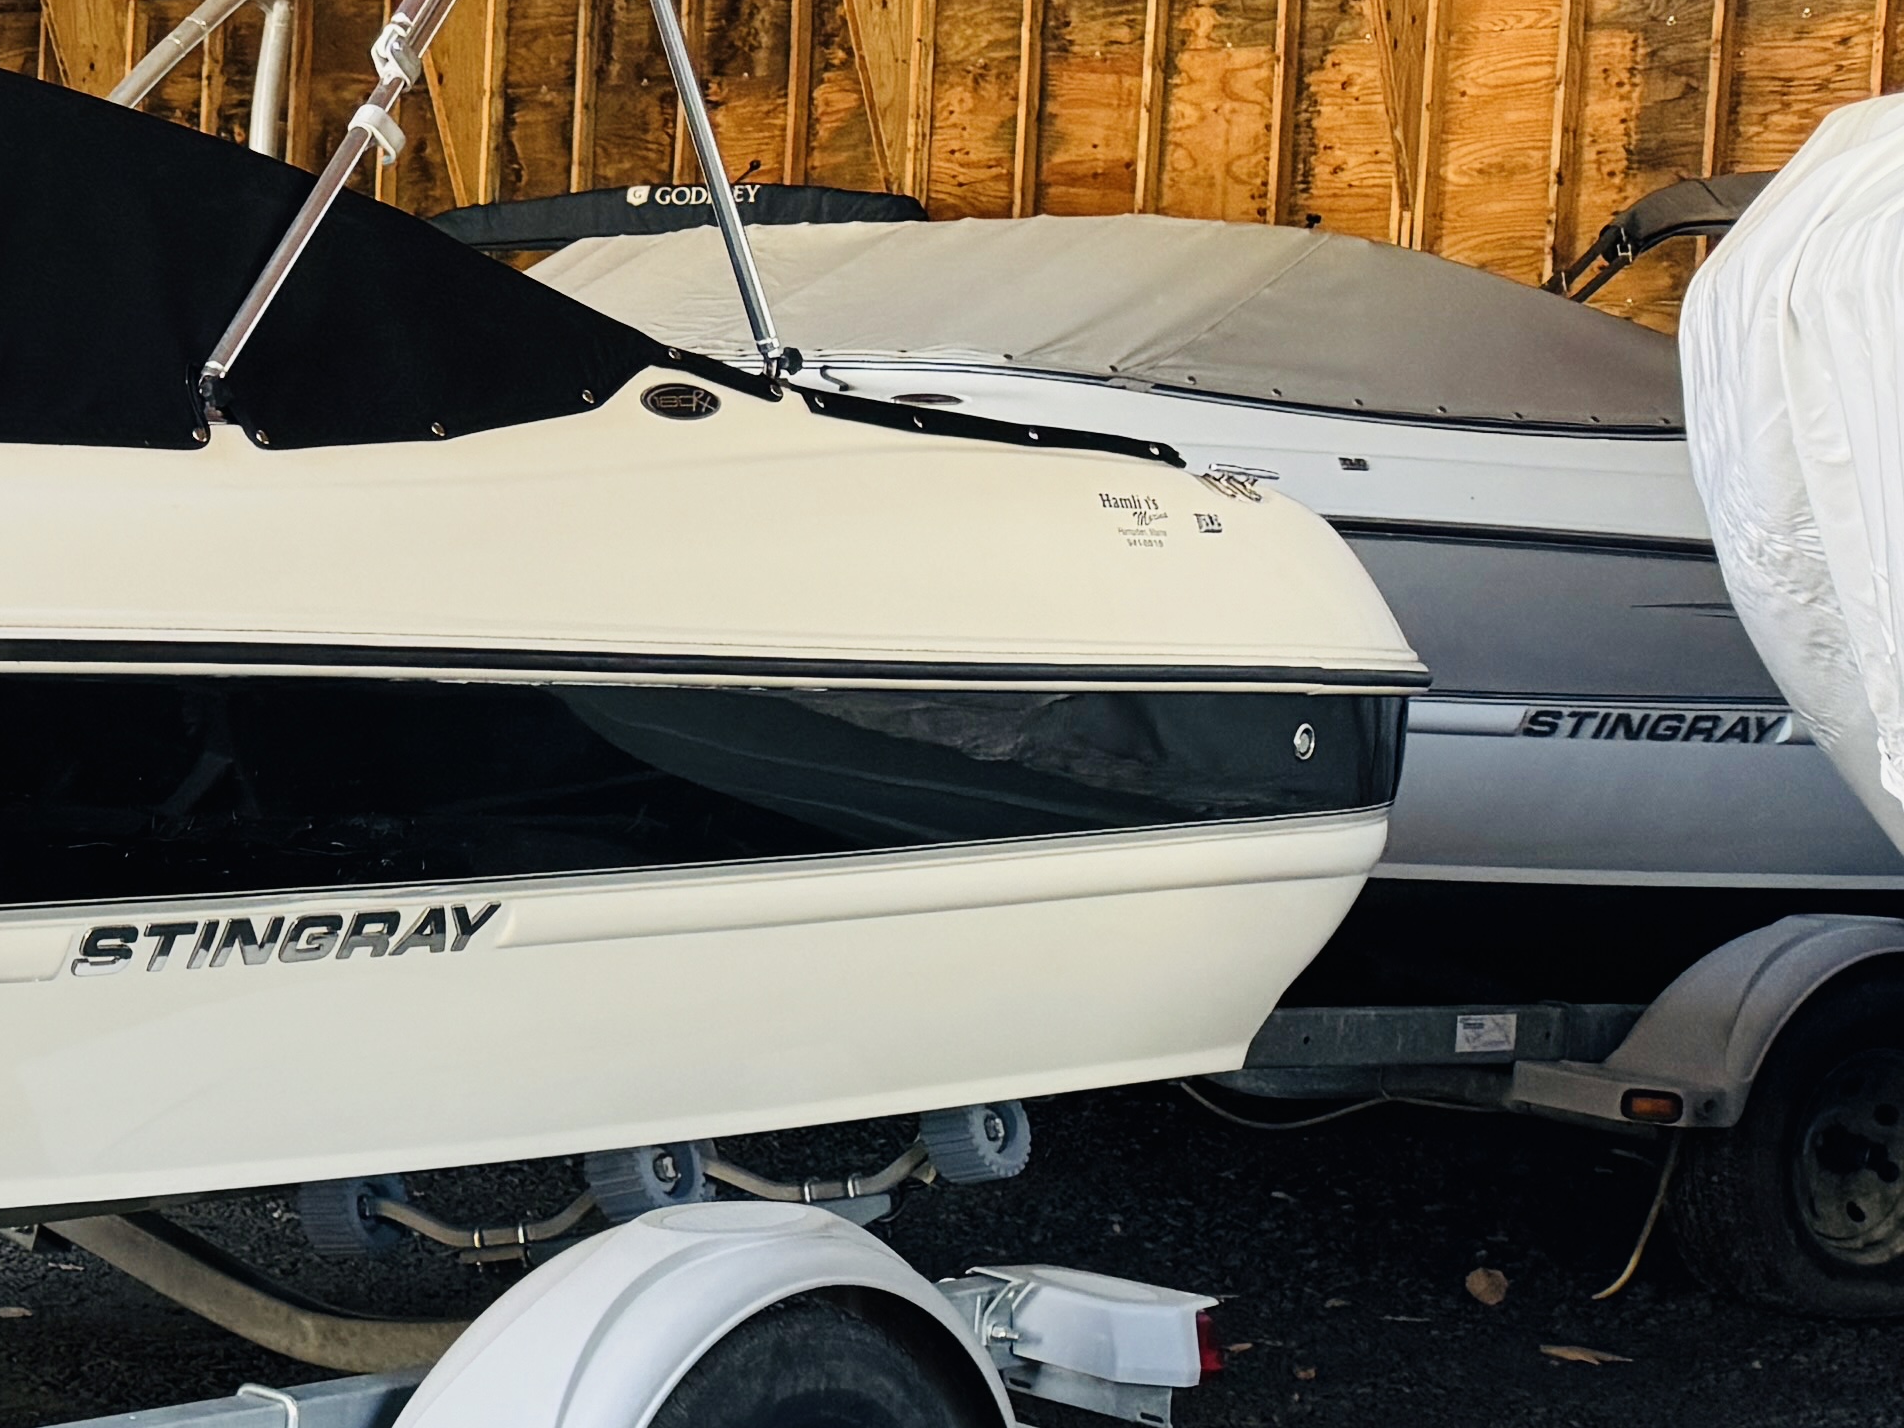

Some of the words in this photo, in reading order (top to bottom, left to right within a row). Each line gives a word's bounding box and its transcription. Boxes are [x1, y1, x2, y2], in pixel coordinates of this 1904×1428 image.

[655, 185, 760, 205] GODEY
[1522, 710, 1787, 744] STINGRAY
[71, 901, 502, 976] STINGRAY
